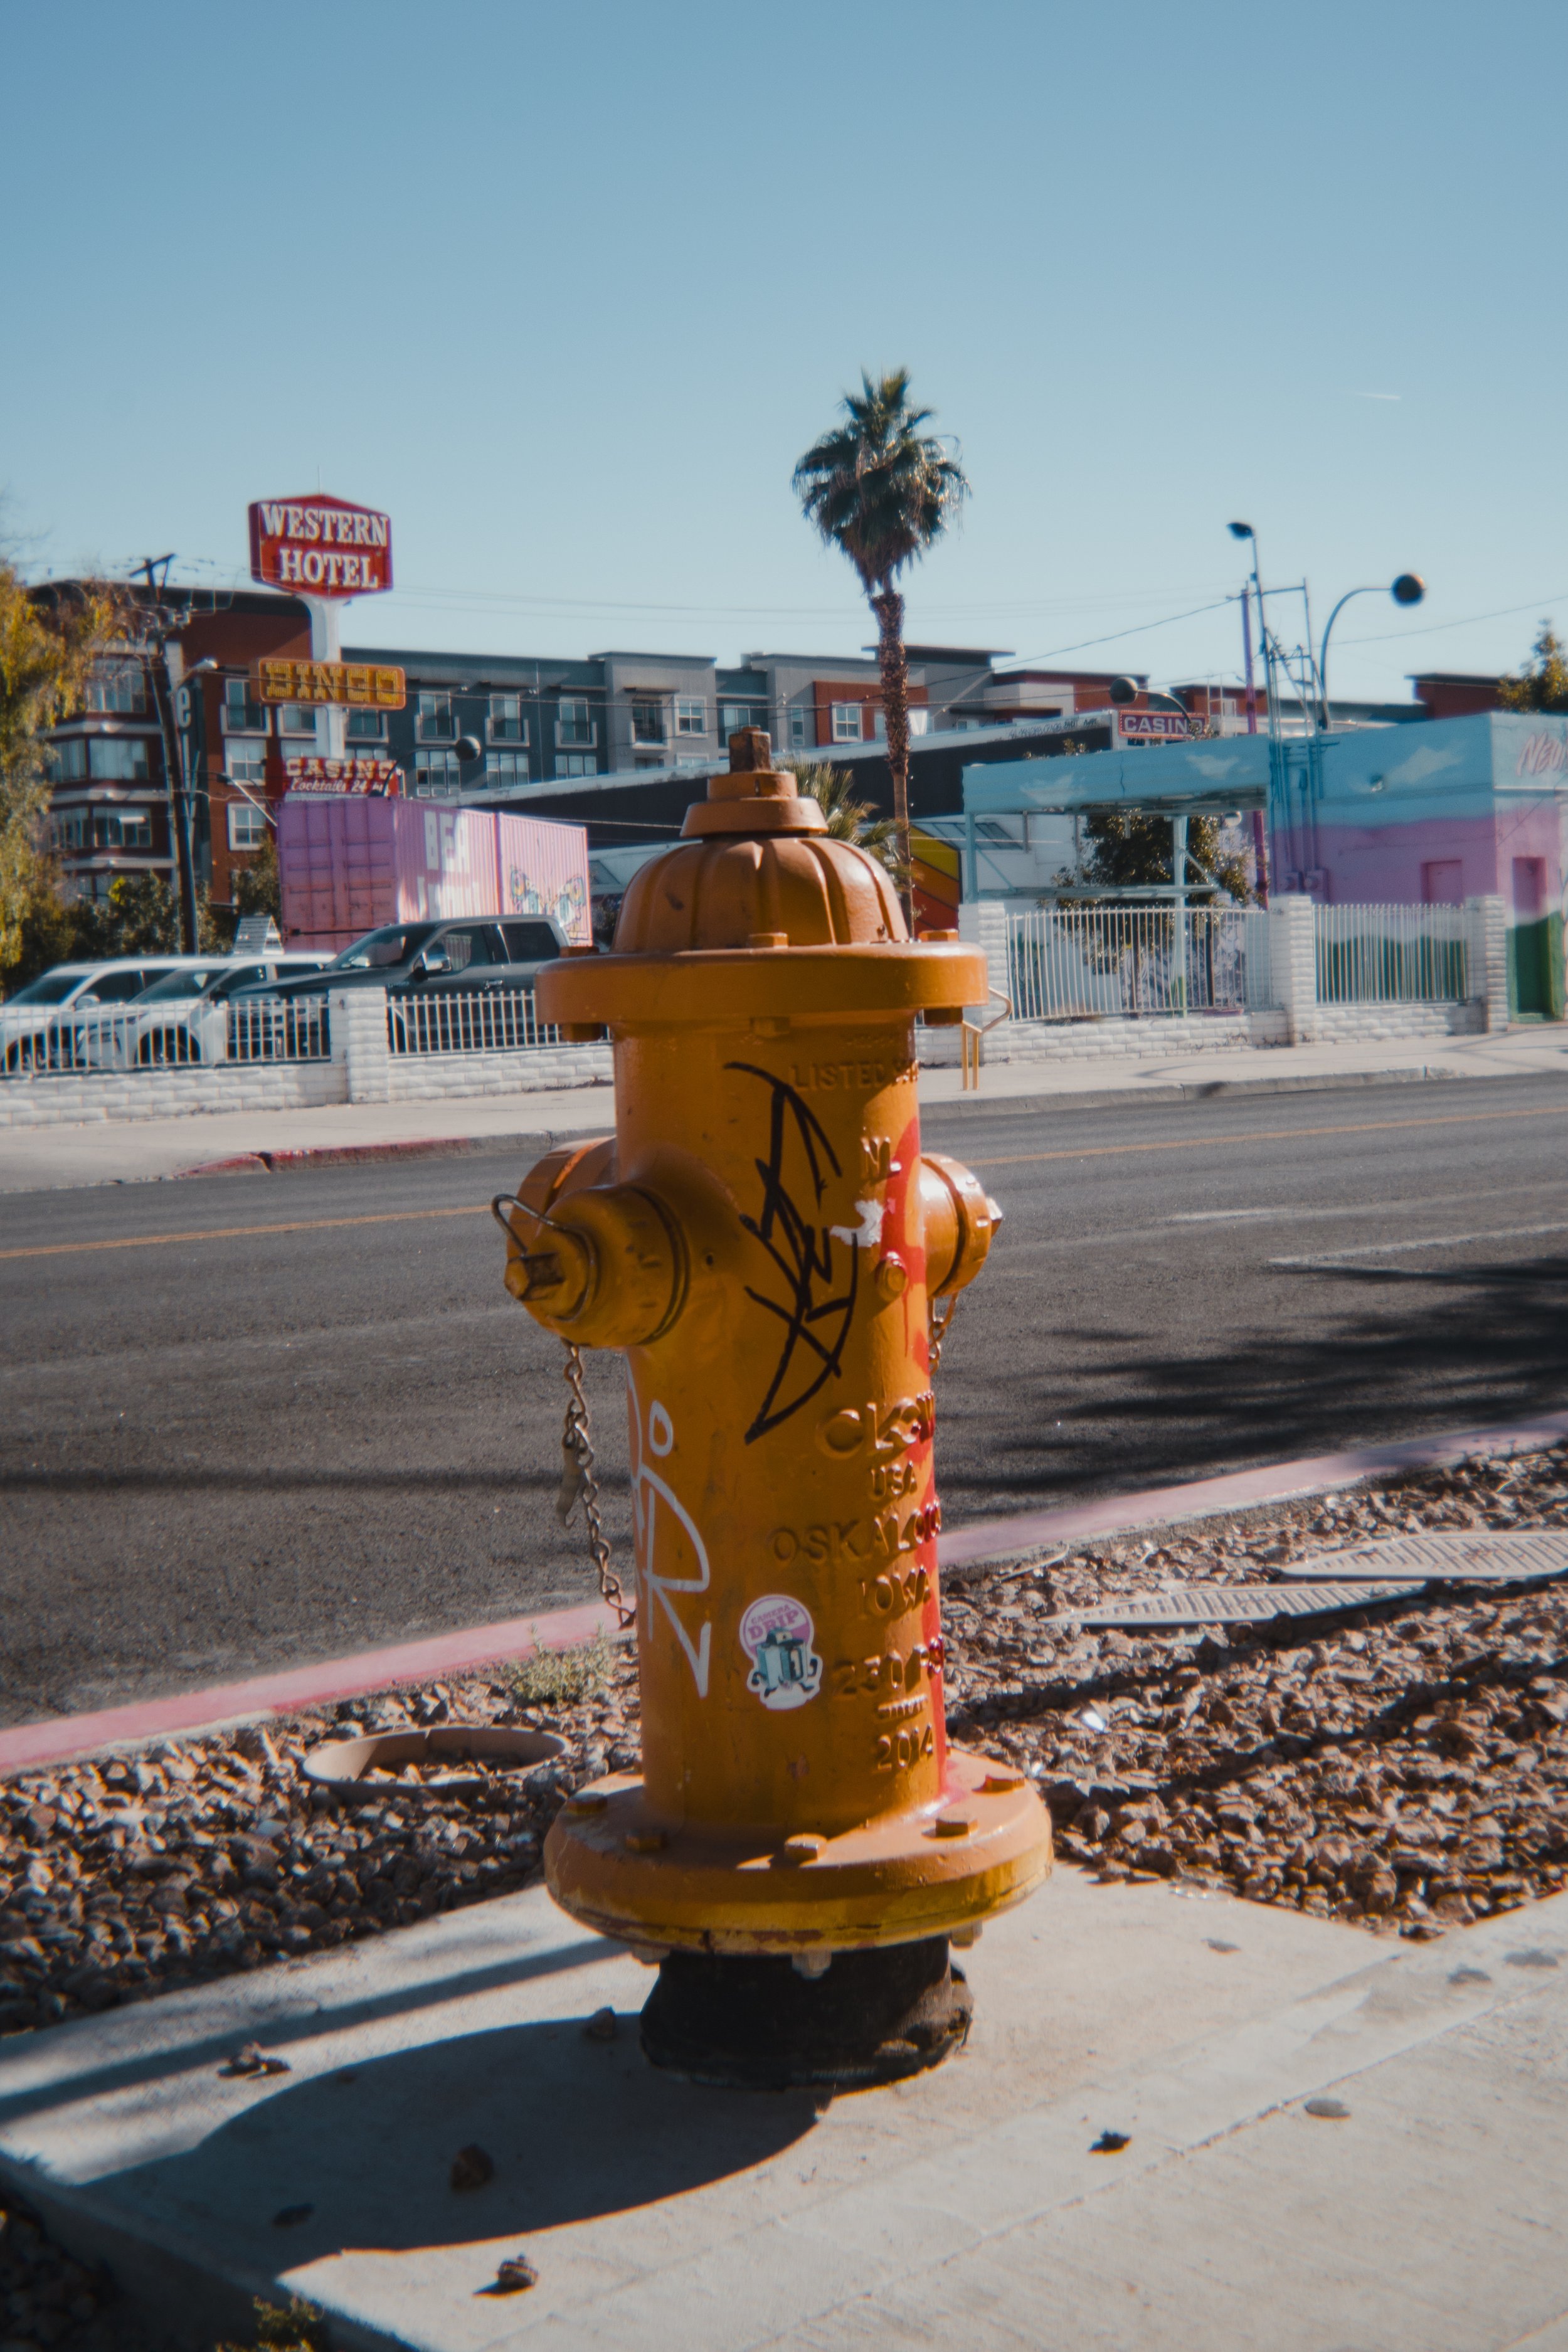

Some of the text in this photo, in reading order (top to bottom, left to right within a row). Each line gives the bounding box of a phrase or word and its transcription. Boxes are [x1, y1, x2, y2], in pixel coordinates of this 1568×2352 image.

[260, 504, 389, 547] WESTERN
[280, 547, 378, 589] HOTEL
[265, 662, 398, 704] BINGO
[291, 776, 347, 792] Cocktails
[351, 778, 368, 793] 24
[870, 1460, 918, 1501] USA
[857, 1565, 932, 1617] IOWA
[748, 1609, 800, 1640] DRIP
[751, 1604, 791, 1624] CAMERA
[874, 1722, 933, 1774] 2014
